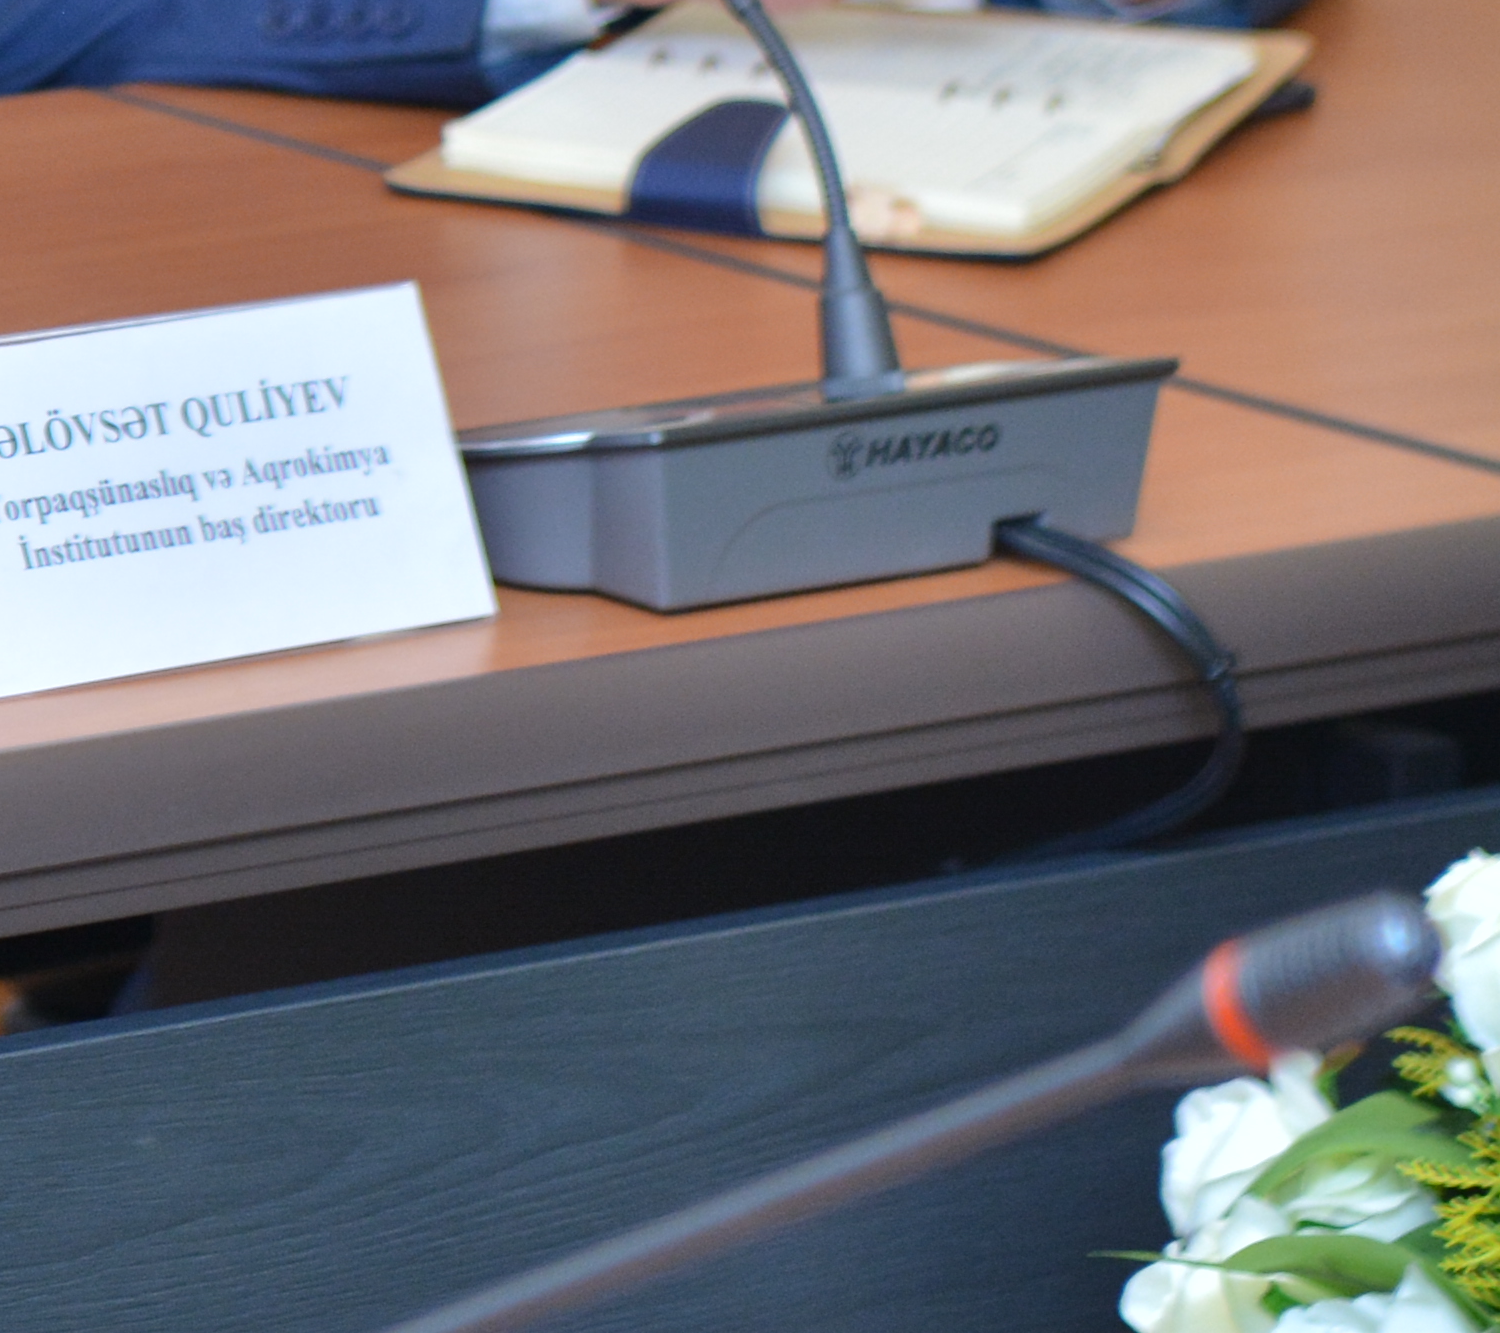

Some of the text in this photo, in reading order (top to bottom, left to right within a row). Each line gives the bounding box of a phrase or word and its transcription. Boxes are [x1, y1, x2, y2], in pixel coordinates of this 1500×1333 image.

[180, 375, 349, 438] QULİYEV
[202, 467, 232, 490] və
[242, 445, 390, 489] Aqrokimya
[865, 423, 1001, 467] HAYACO
[17, 496, 381, 570] İnstitutunun baş direktoru
